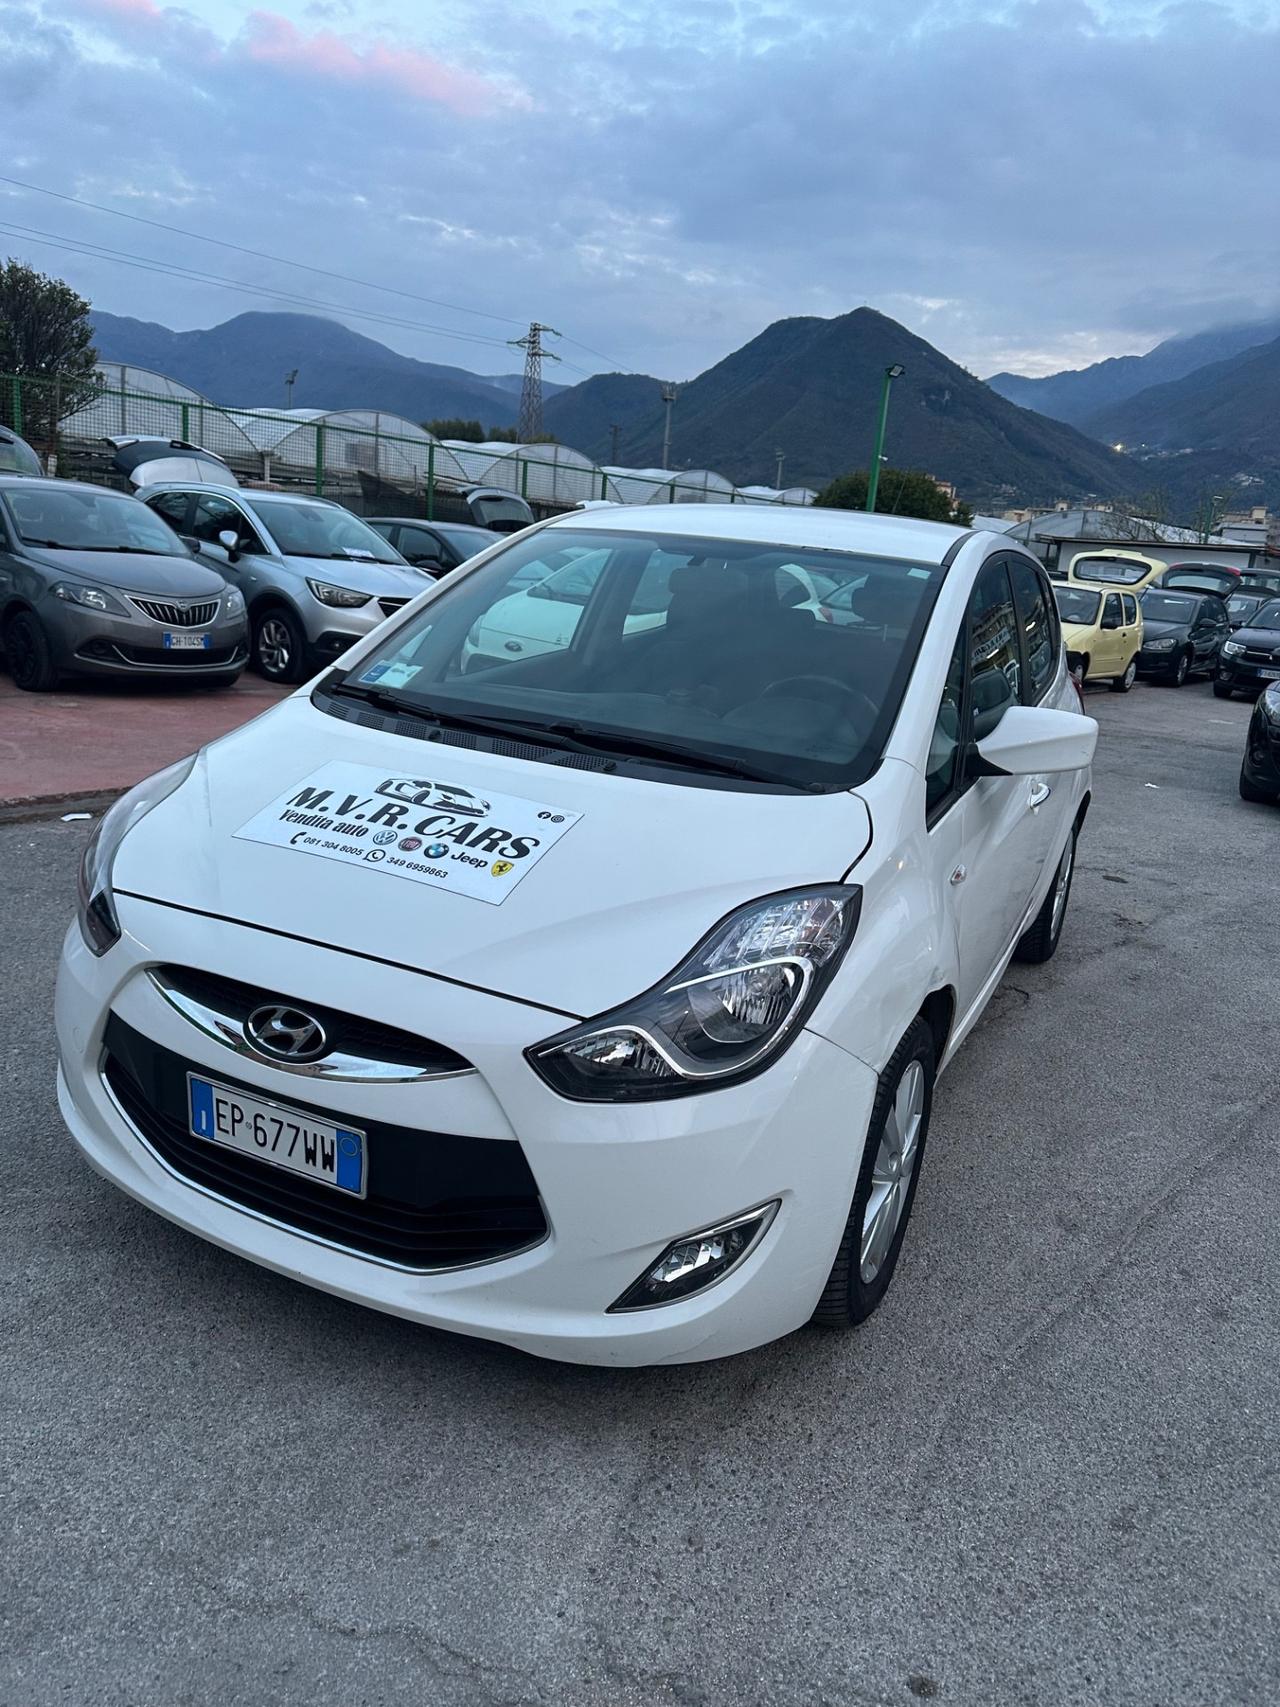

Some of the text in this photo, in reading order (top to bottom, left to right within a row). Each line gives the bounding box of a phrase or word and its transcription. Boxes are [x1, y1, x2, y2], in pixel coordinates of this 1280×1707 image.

[279, 809, 370, 837] Vendita auto
[303, 837, 365, 856] 081 304 8005
[386, 857, 449, 879] 349 6959863
[451, 851, 489, 869] Jeep
